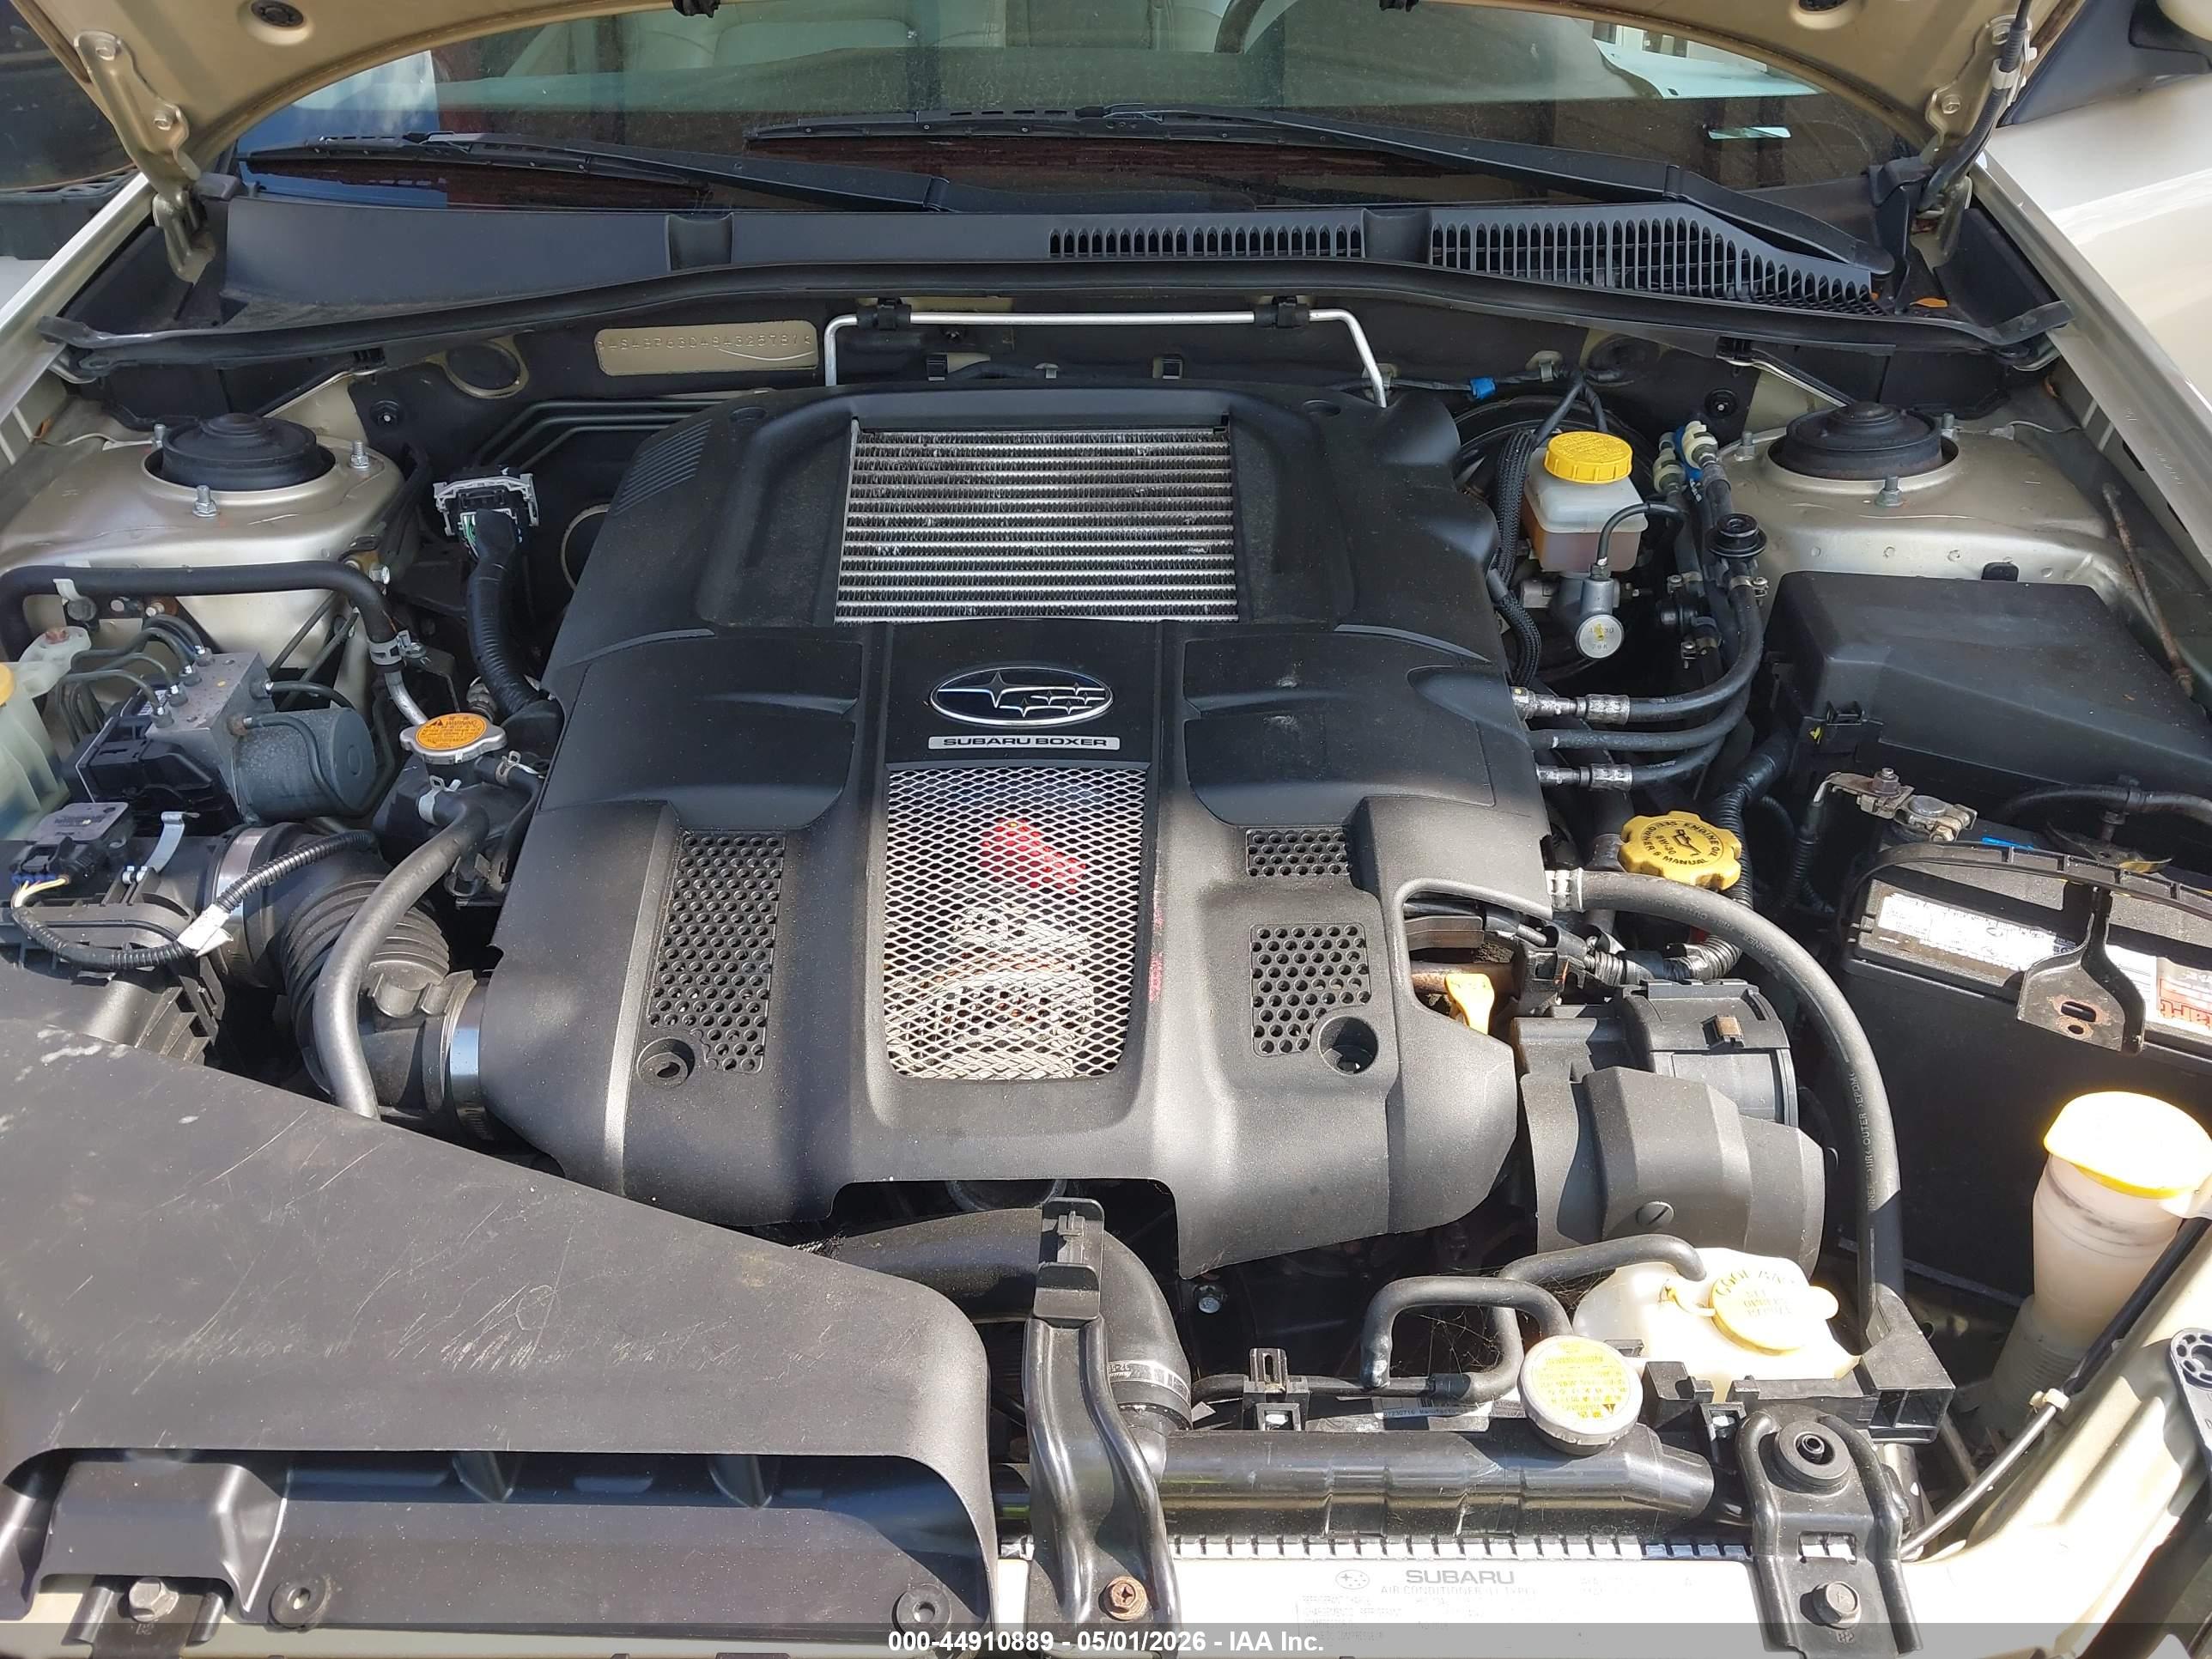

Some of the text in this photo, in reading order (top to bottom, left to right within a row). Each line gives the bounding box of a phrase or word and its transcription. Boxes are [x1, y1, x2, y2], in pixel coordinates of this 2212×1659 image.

[943, 737, 1108, 747] SUBARU BOXER
[1684, 822, 1722, 858] ENGINE OIL
[1662, 855, 1709, 866] MANUAL
[1858, 1112, 1871, 1146] OUTER
[1406, 1570, 1515, 1584] SUBARU
